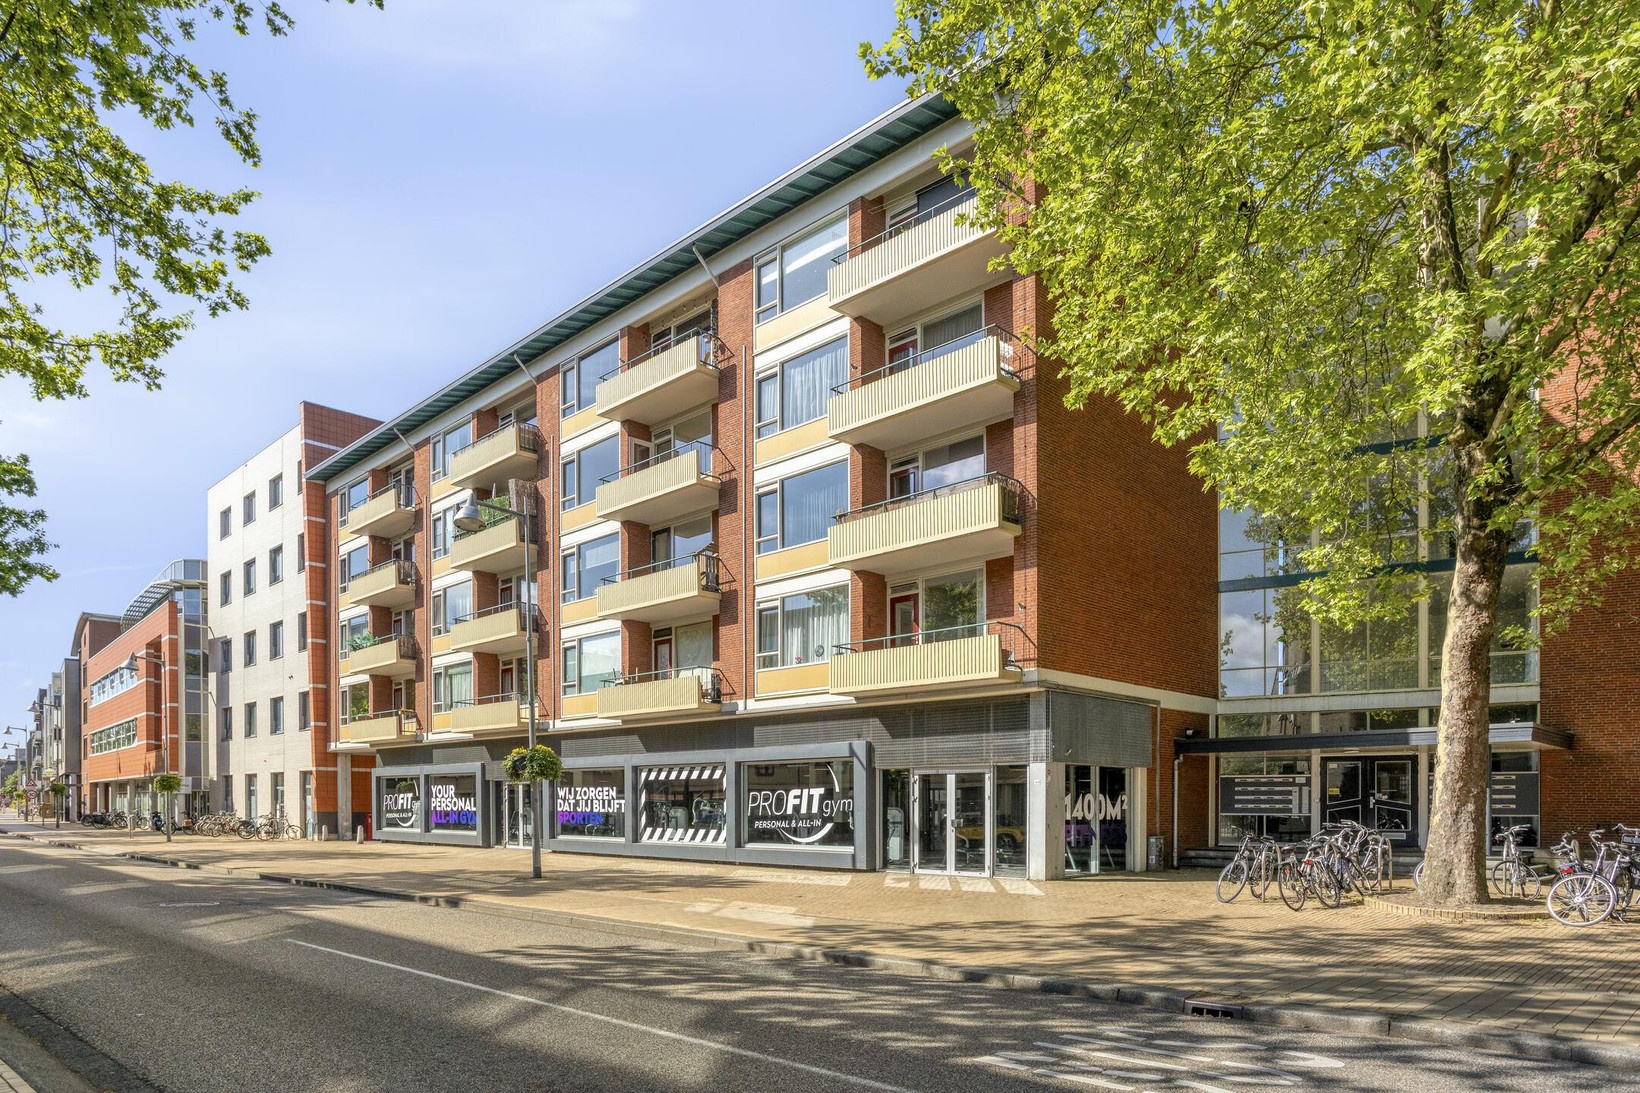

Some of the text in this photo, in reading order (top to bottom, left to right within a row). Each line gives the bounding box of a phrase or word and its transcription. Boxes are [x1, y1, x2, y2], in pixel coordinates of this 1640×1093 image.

[431, 785, 454, 798] YOUR
[557, 787, 616, 799] WIJ ZORGEN
[384, 793, 413, 810] PROFIT
[431, 797, 476, 811] PERSONAL
[558, 800, 625, 812] DAT JIJ BLIJFT
[748, 788, 853, 817] PROFIT gym
[431, 810, 458, 823] ALL-IN
[557, 811, 602, 824] SPORTEN
[755, 820, 790, 828] PERSONAL
[797, 819, 822, 827] ALL-IN
